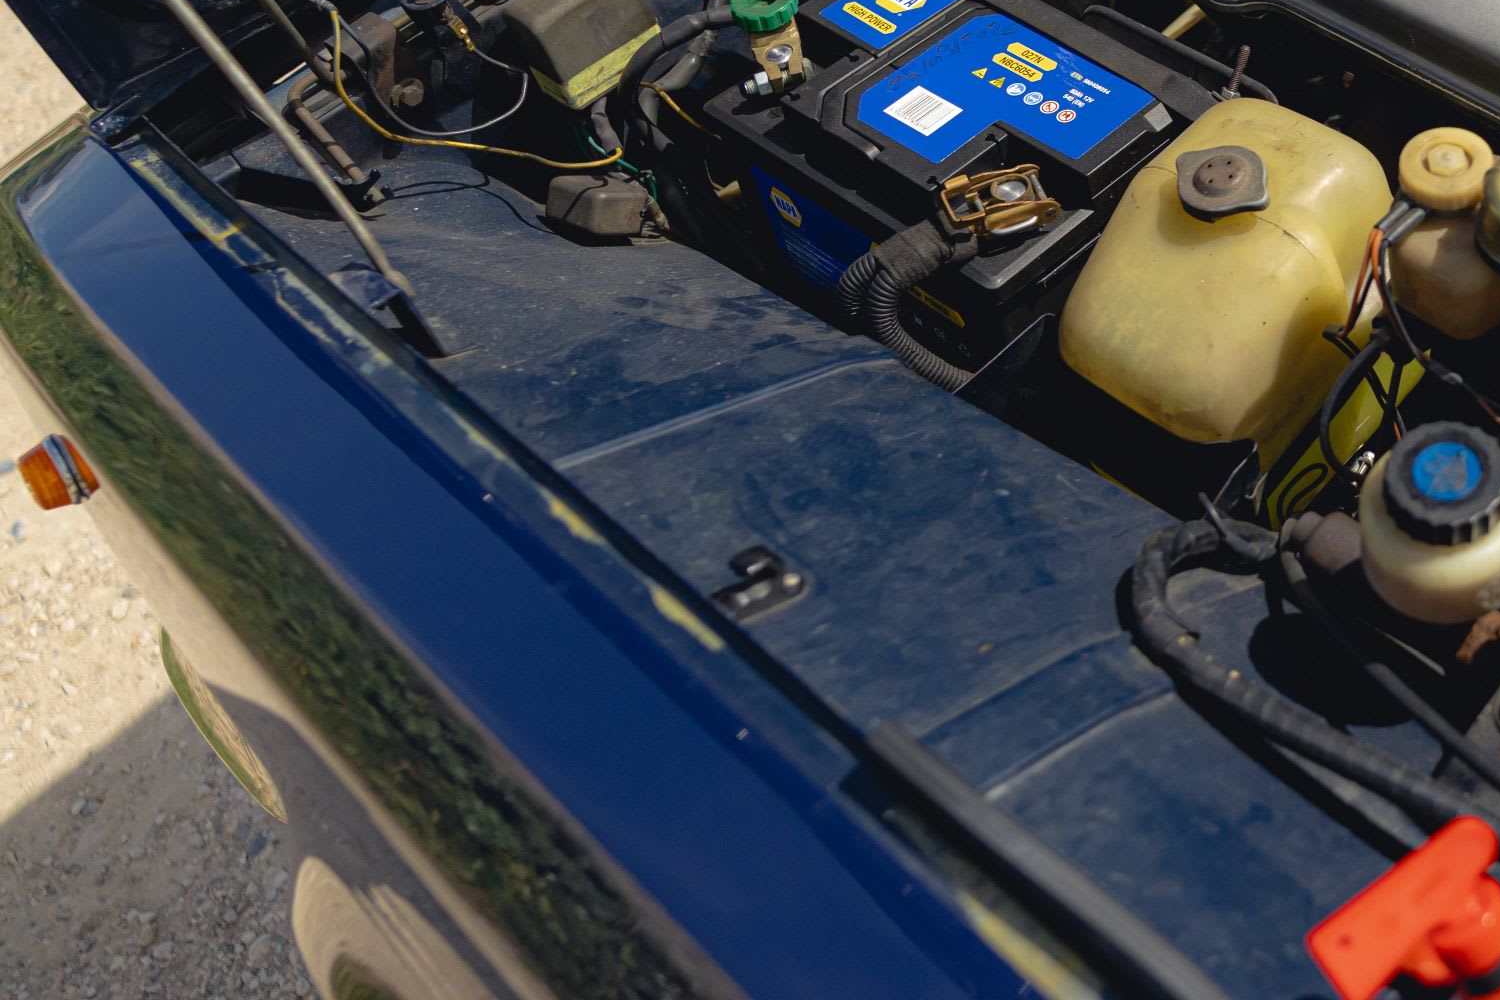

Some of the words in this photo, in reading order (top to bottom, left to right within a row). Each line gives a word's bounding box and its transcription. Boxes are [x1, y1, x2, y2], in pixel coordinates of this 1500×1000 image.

[847, 4, 866, 18] HIGH
[864, 12, 892, 32] POWER
[1000, 56, 1036, 79] NBC6054
[1021, 49, 1045, 64] 027N
